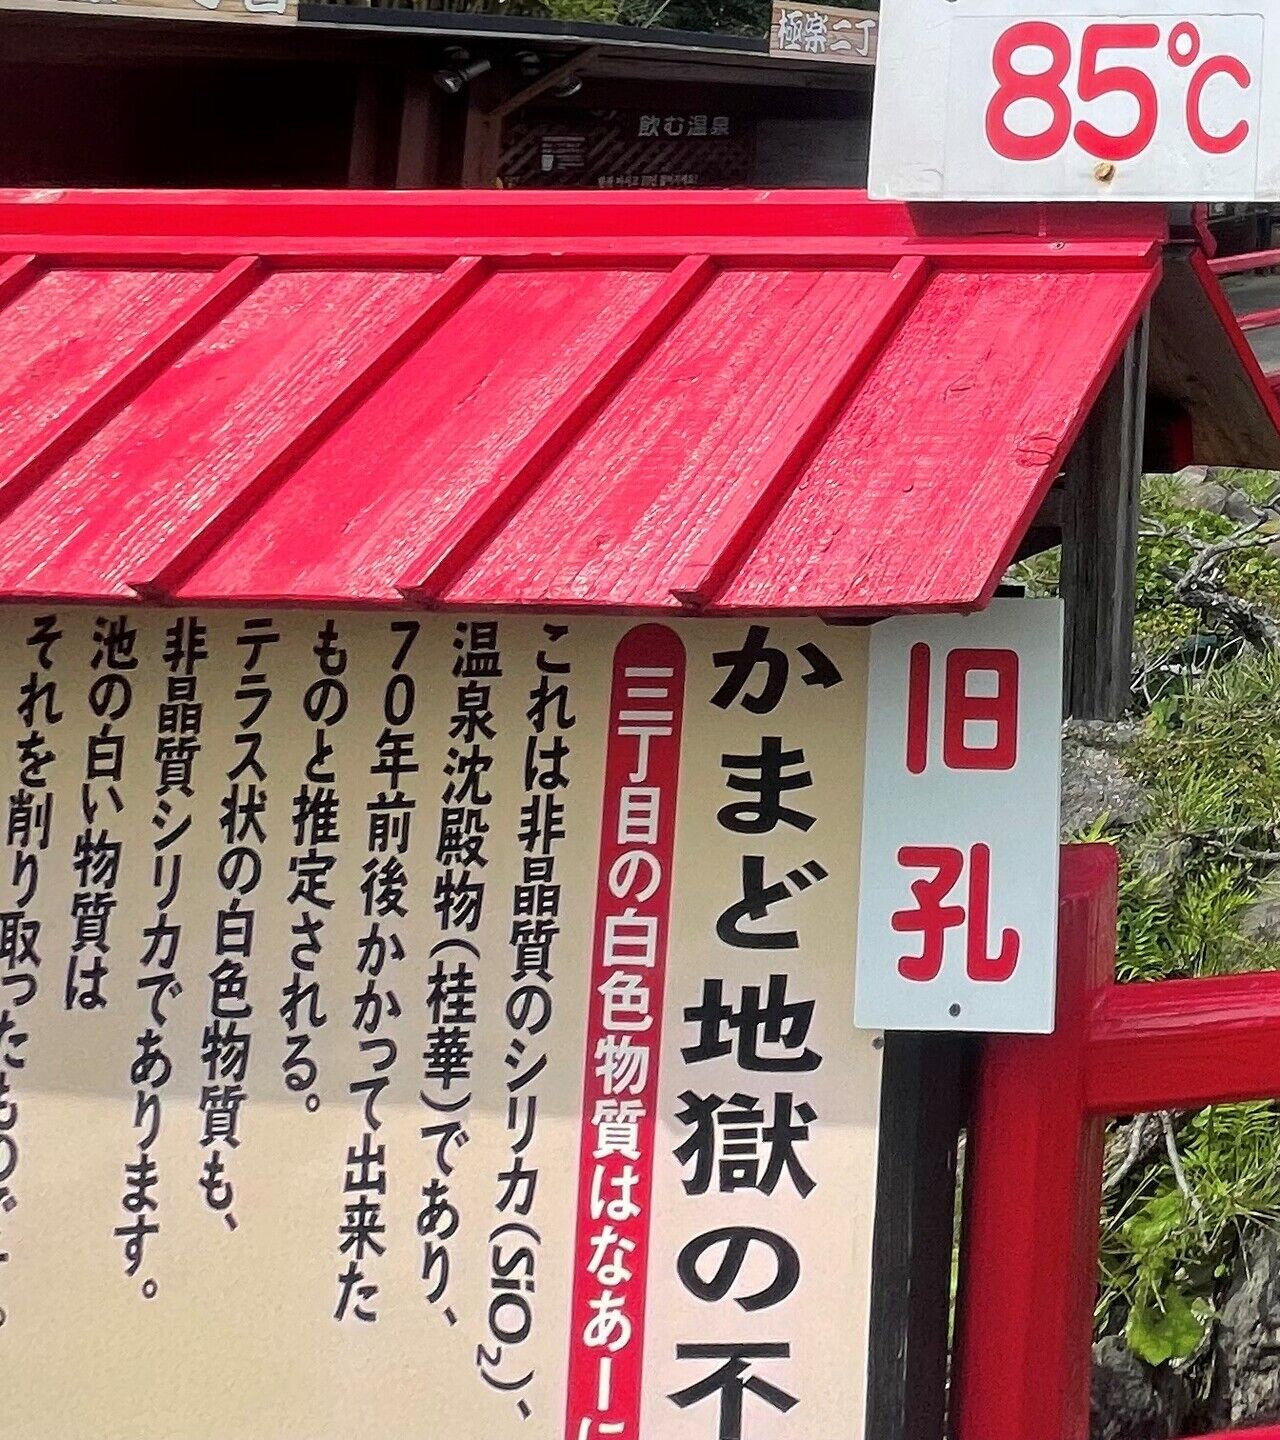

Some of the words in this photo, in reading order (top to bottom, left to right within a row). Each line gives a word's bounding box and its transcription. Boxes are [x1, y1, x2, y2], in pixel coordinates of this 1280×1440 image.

[638, 115, 730, 136] 飲む温泉
[65, 615, 139, 1010] 池の白い物質は
[114, 616, 208, 1300] 非晶質シリカであります。
[198, 617, 281, 1231] テラス状の白色物質も、
[279, 620, 349, 1114] ものと推定される。
[334, 621, 419, 1322] 70年前後かかって出来た
[891, 642, 1021, 984] 旧孔
